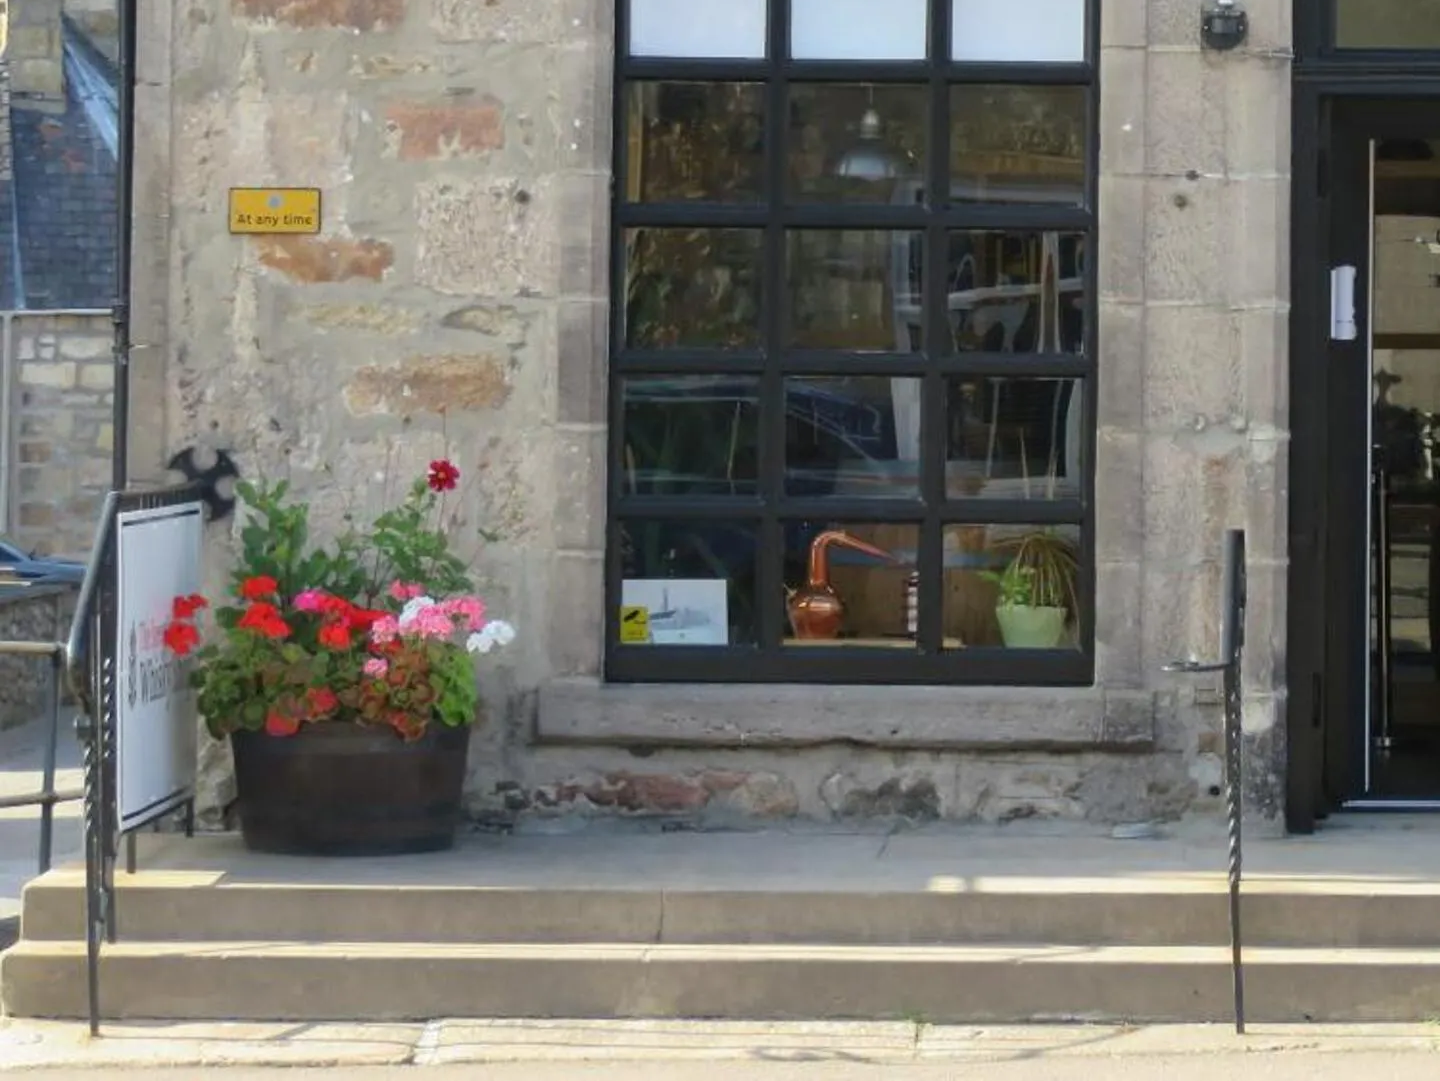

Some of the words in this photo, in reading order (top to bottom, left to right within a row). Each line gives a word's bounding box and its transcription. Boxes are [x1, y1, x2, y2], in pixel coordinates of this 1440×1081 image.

[237, 214, 252, 225] At
[256, 216, 278, 227] any
[284, 214, 312, 225] time
